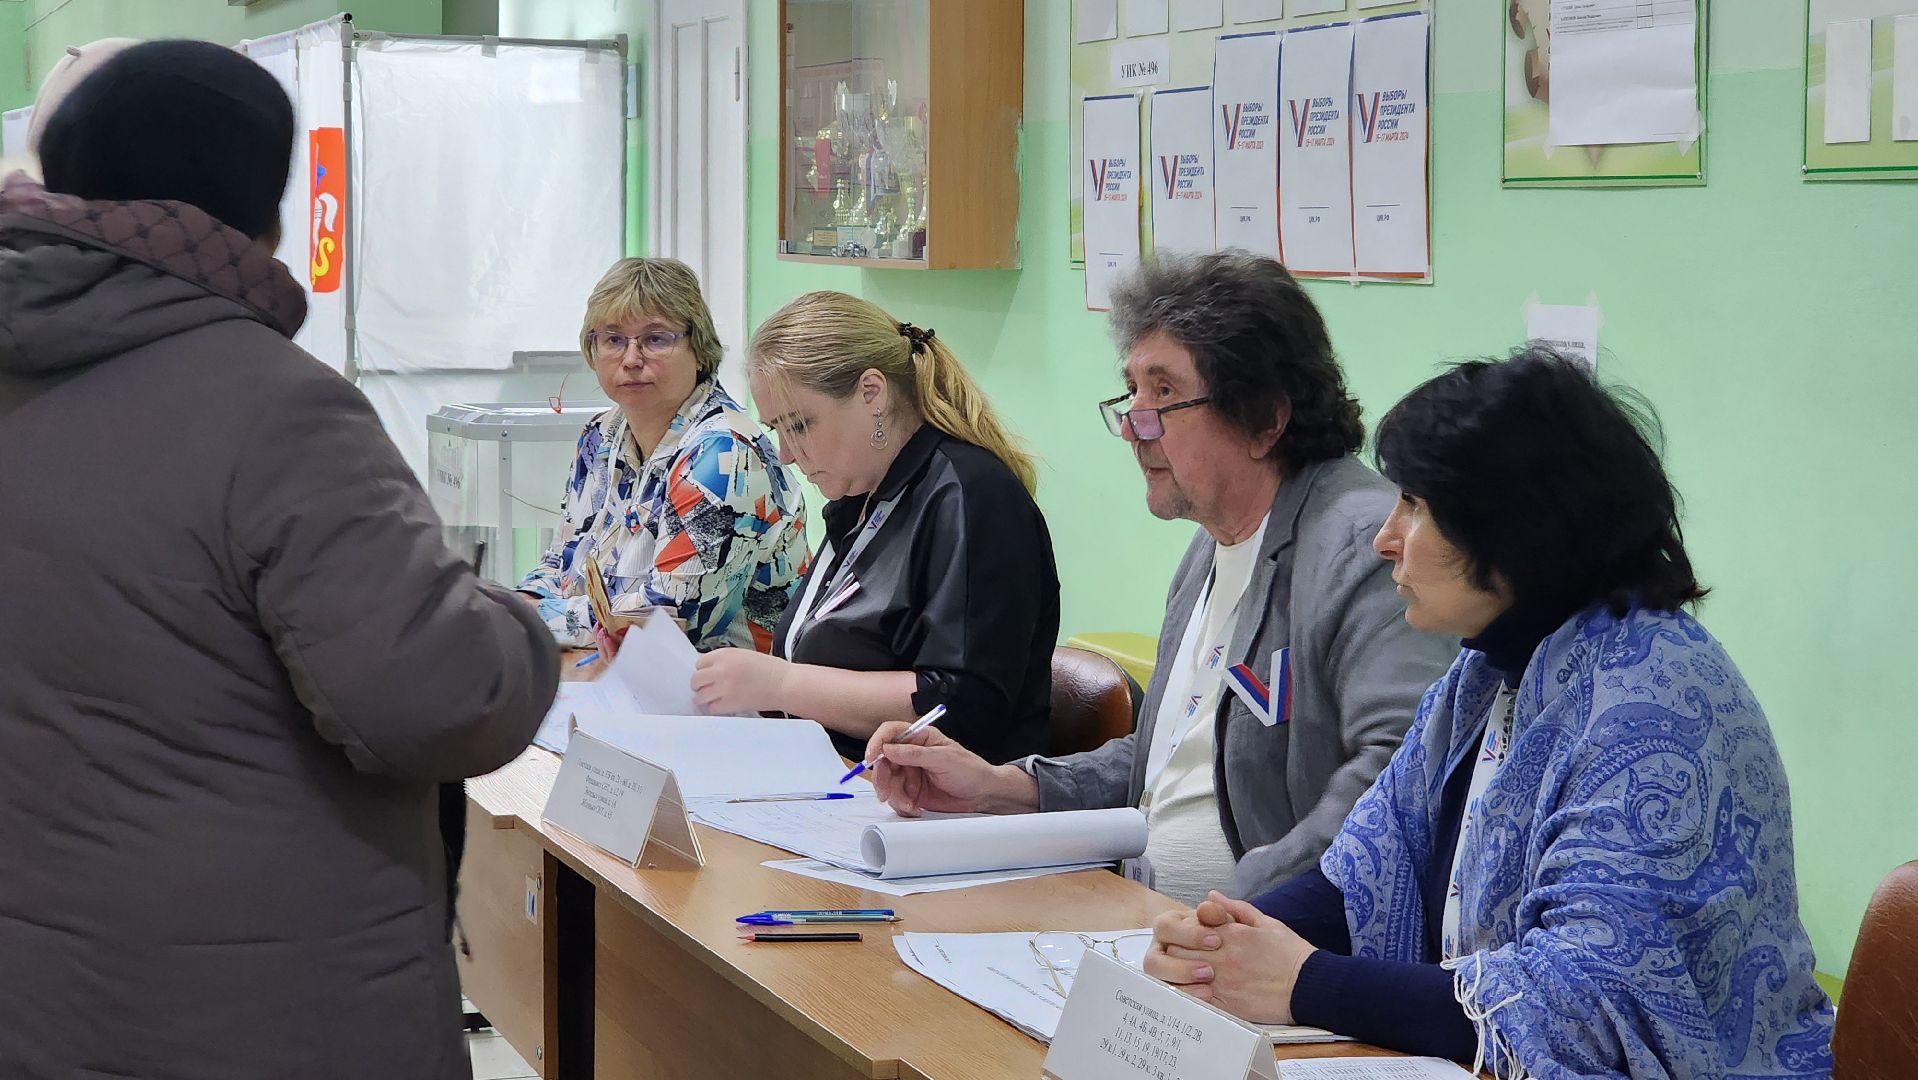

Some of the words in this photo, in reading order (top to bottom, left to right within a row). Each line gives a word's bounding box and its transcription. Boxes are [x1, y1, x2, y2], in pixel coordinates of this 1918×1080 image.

[1121, 63, 1137, 79] УИК
[1138, 62, 1146, 76] №
[1147, 60, 1159, 75] 496
[1382, 89, 1408, 101] ВЫБОРЫ
[1243, 102, 1263, 112] ВЫБОРЫ
[1312, 97, 1334, 107] ВЫБОРЫ
[1380, 103, 1416, 115] ПРЕЗИДЕНТА
[1310, 110, 1340, 121] ПРЕЗИДЕНТА
[1240, 116, 1270, 126] ПРЕЗИДЕНТА
[1377, 119, 1400, 130] РОССИИ
[1239, 129, 1257, 139] РОССИИ
[1308, 125, 1327, 135] РОССИИ
[1108, 159, 1126, 168] ВЫБОРЫ
[1180, 154, 1199, 164] ВЫБОРЫ
[1106, 170, 1132, 180] ПРЕЗИДЕНТА
[1179, 167, 1205, 176] ПРЕЗИДЕНТА
[1105, 183, 1120, 192] РОССИИ
[1177, 179, 1193, 189] РОССИИ
[1115, 989, 1141, 1011] Советская
[1167, 1015, 1180, 1033] 1/14,
[1122, 1012, 1128, 1024] 4,
[1142, 1041, 1150, 1056] 19,
[1168, 1054, 1178, 1070] 23,
